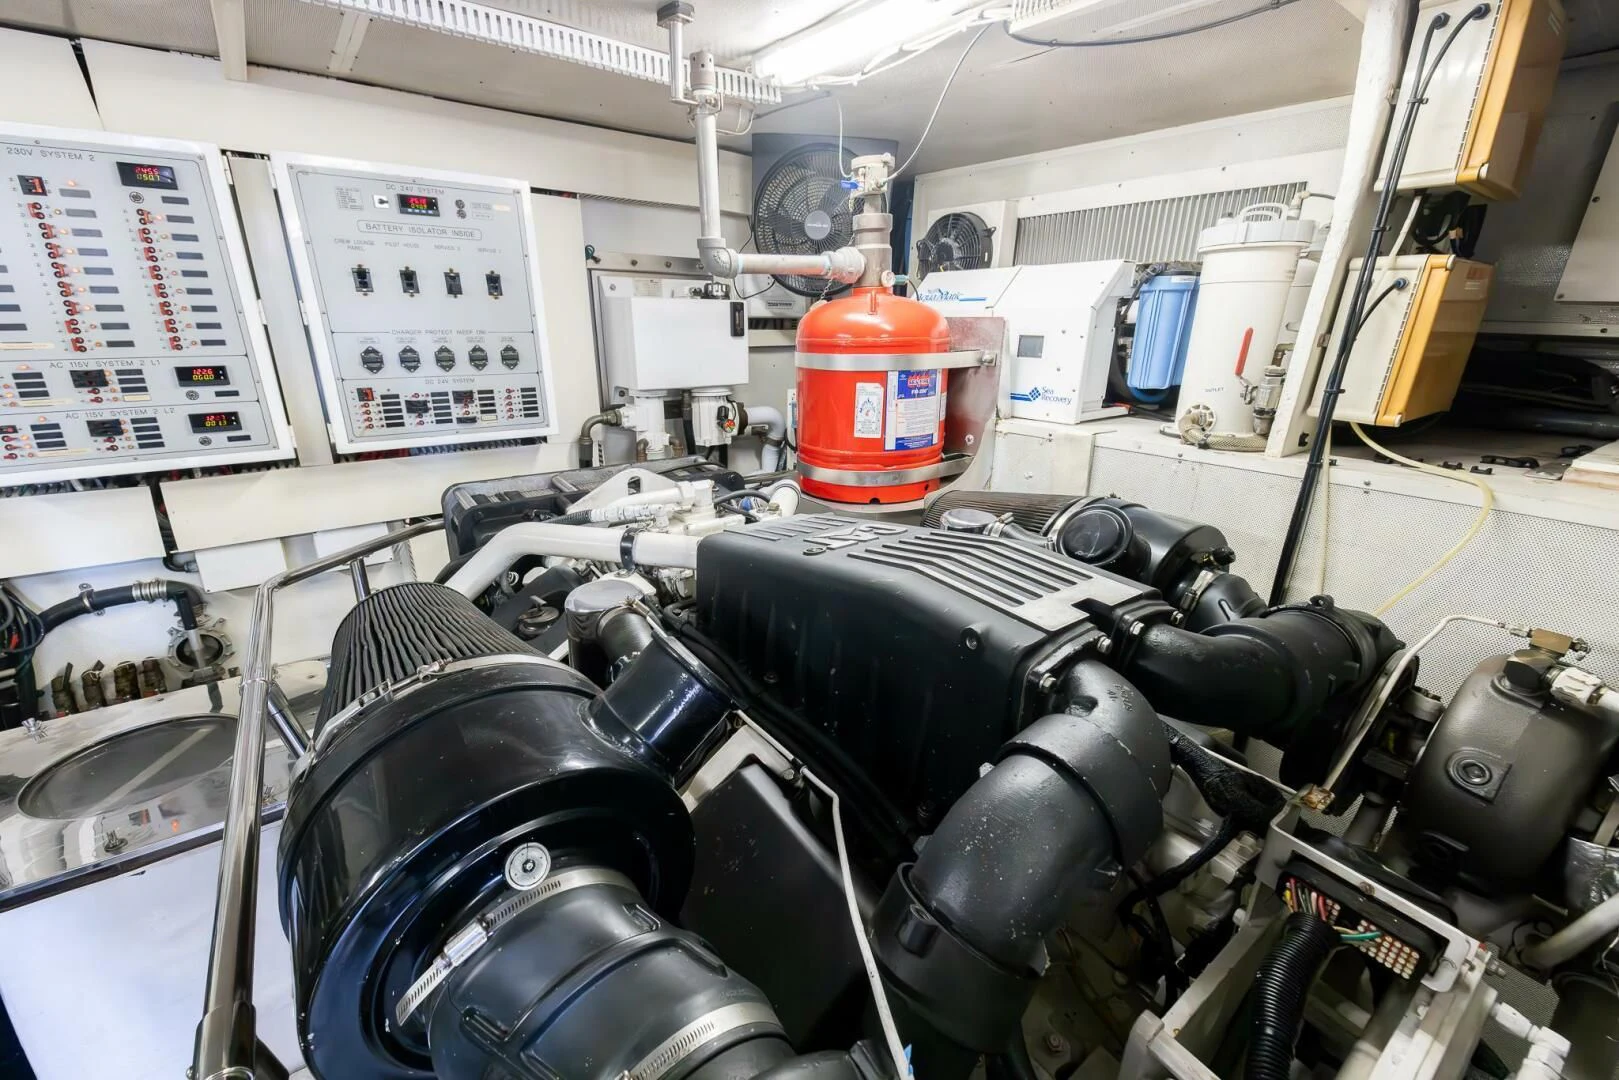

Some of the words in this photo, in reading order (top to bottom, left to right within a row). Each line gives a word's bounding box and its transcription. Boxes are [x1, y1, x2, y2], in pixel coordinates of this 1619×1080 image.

[6, 147, 33, 156] 230V
[40, 149, 83, 161] SYSTEM
[365, 223, 403, 233] BATTERY
[408, 226, 448, 235] ISOLATOR
[451, 229, 476, 238] INSIDE
[96, 360, 134, 368] SYSTEM
[1041, 386, 1054, 394] Sea
[1041, 392, 1072, 406] Recovery
[110, 409, 148, 417] SYSTEM
